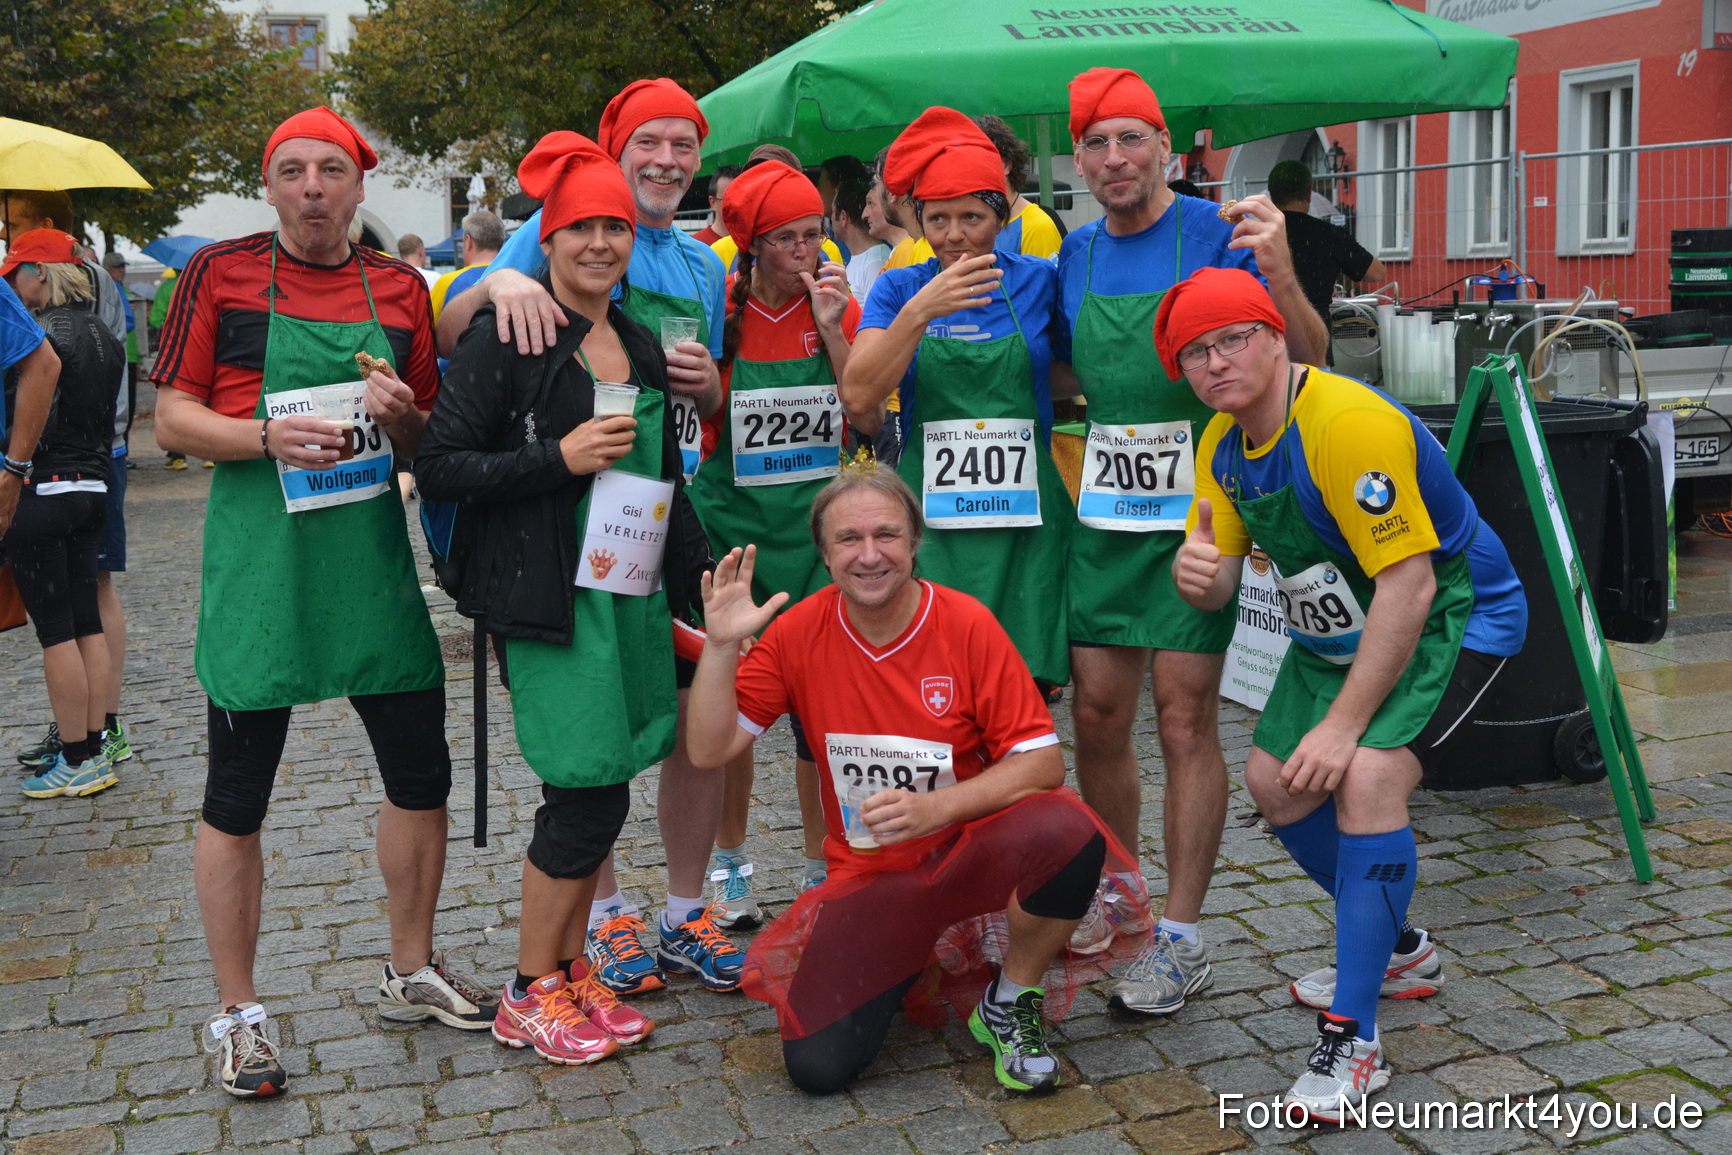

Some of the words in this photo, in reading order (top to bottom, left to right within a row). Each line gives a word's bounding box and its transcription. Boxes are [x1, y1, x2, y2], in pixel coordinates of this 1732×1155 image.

[1029, 5, 1240, 21] Neumarkter
[1001, 17, 1302, 40] Lammsbräu
[1677, 49, 1698, 77] 19
[270, 401, 314, 417] PARTL
[733, 398, 771, 409] PARTL
[773, 396, 823, 408] Neumarkt
[673, 402, 698, 445] 96
[743, 410, 834, 449] 2224
[926, 431, 962, 443] PARTL
[964, 430, 1018, 440] Neumarkt
[1089, 431, 1113, 446] PARTL
[1114, 434, 1170, 446] Neumarkt
[764, 453, 813, 472] Brigitte
[935, 445, 1027, 487] 2407
[1094, 449, 1181, 491] 2067
[306, 467, 377, 492] Wolfgang
[622, 505, 643, 518] Gisi
[955, 496, 1010, 513] Carolin
[1114, 500, 1161, 516] Gisela
[1370, 514, 1408, 538] PARTL
[1240, 583, 1280, 607] eumarkt
[1237, 656, 1257, 672] Genuss
[1259, 665, 1277, 678] schaff
[1274, 653, 1284, 665] leb
[829, 745, 868, 758] PARTL
[870, 748, 928, 759] Neumarkt
